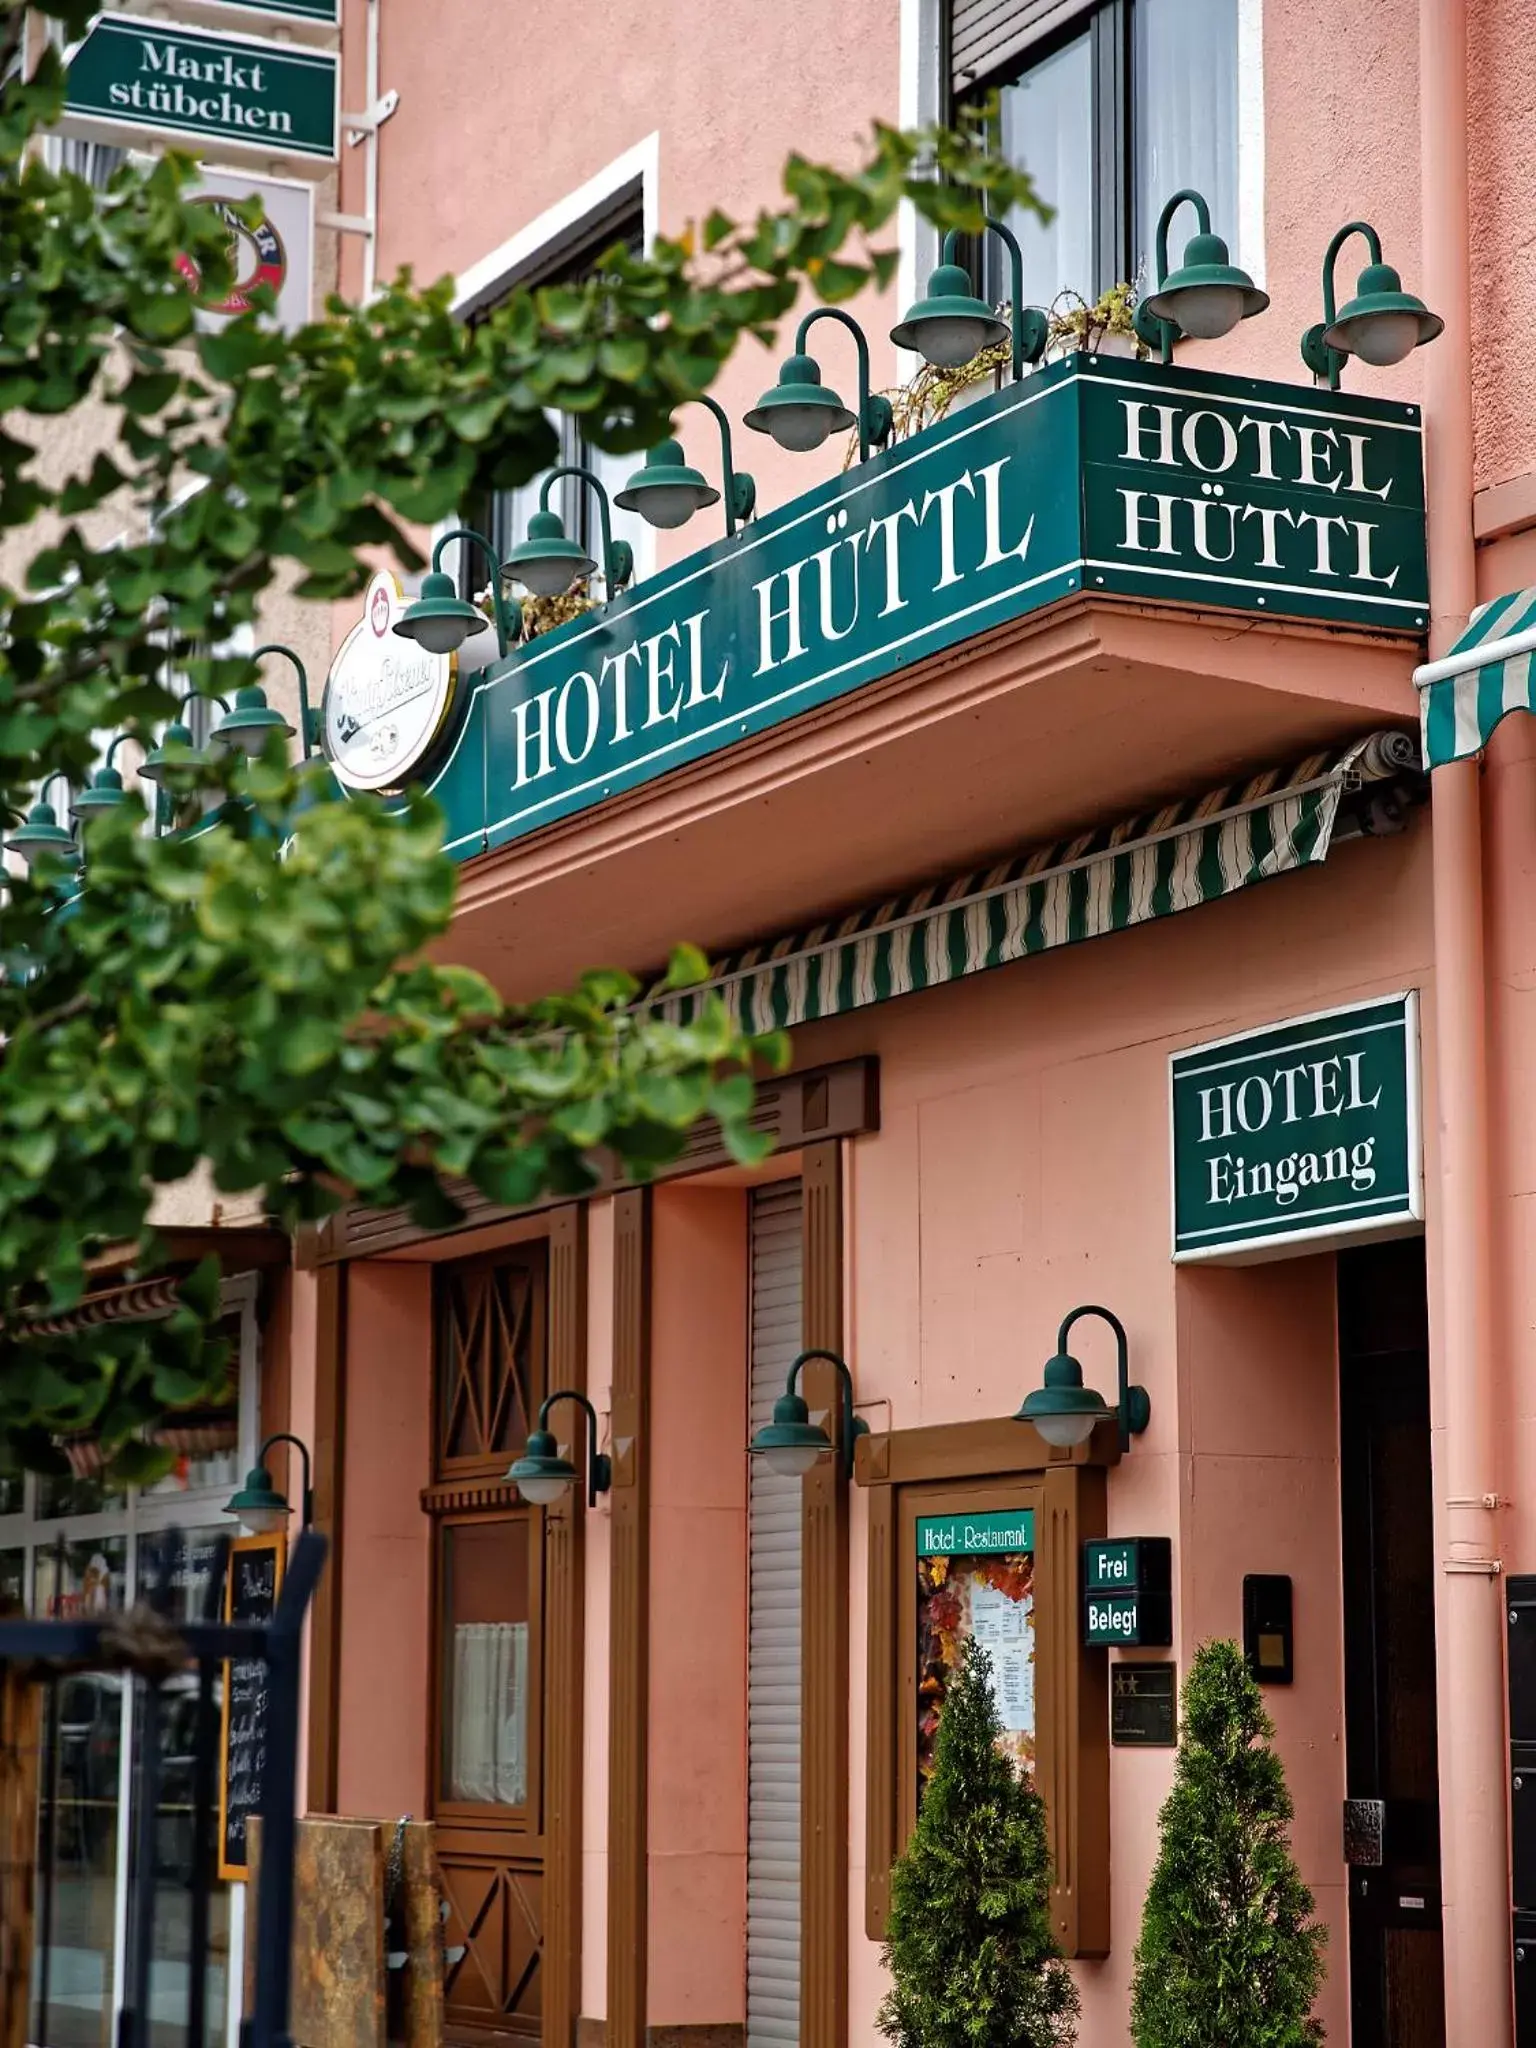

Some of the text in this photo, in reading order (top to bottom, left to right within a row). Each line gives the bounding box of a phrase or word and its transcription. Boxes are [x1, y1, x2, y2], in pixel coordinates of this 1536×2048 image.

[139, 40, 268, 92] Markt
[108, 80, 293, 133] stübchen
[1117, 399, 1393, 501] HOTEL
[1116, 482, 1400, 590] HÜTTL
[511, 455, 1036, 791] HOTEL HÜTTL
[1196, 1050, 1383, 1143] HOTEL
[1205, 1135, 1376, 1206] Eingang
[924, 1525, 956, 1551] Hotel
[963, 1523, 1028, 1549] Restaurant
[1098, 1551, 1128, 1579] Frei
[1088, 1603, 1137, 1636] Belegt
